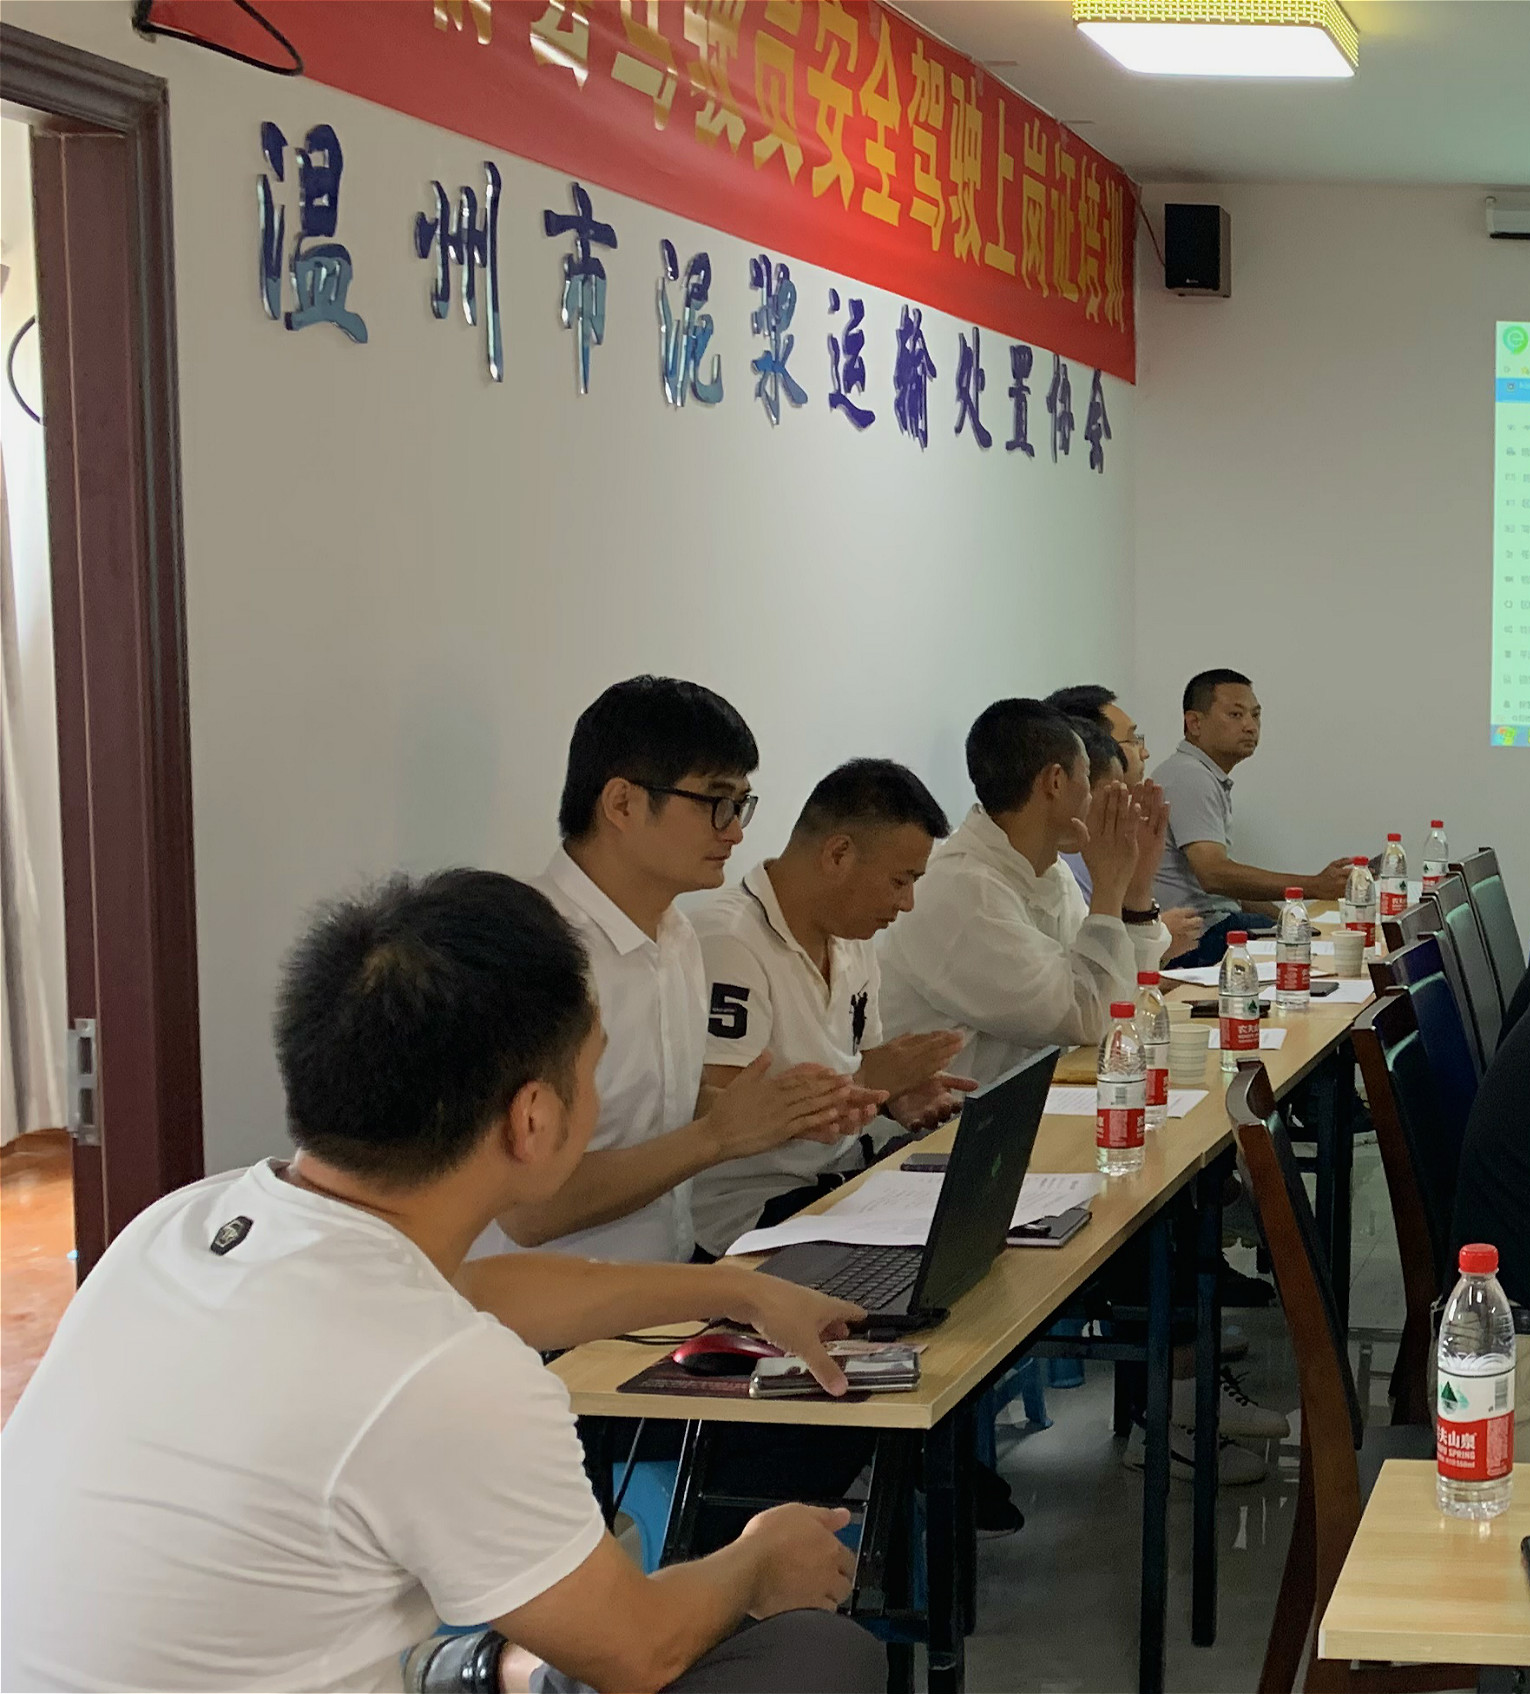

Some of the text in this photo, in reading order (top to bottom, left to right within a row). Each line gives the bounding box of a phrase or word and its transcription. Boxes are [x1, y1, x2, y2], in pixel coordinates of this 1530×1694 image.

[256, 121, 1113, 474] 温州市泥浆运输处置协会
[433, 0, 1125, 333] 驶员安全驾驶上岗证培训
[708, 982, 751, 1040] 5
